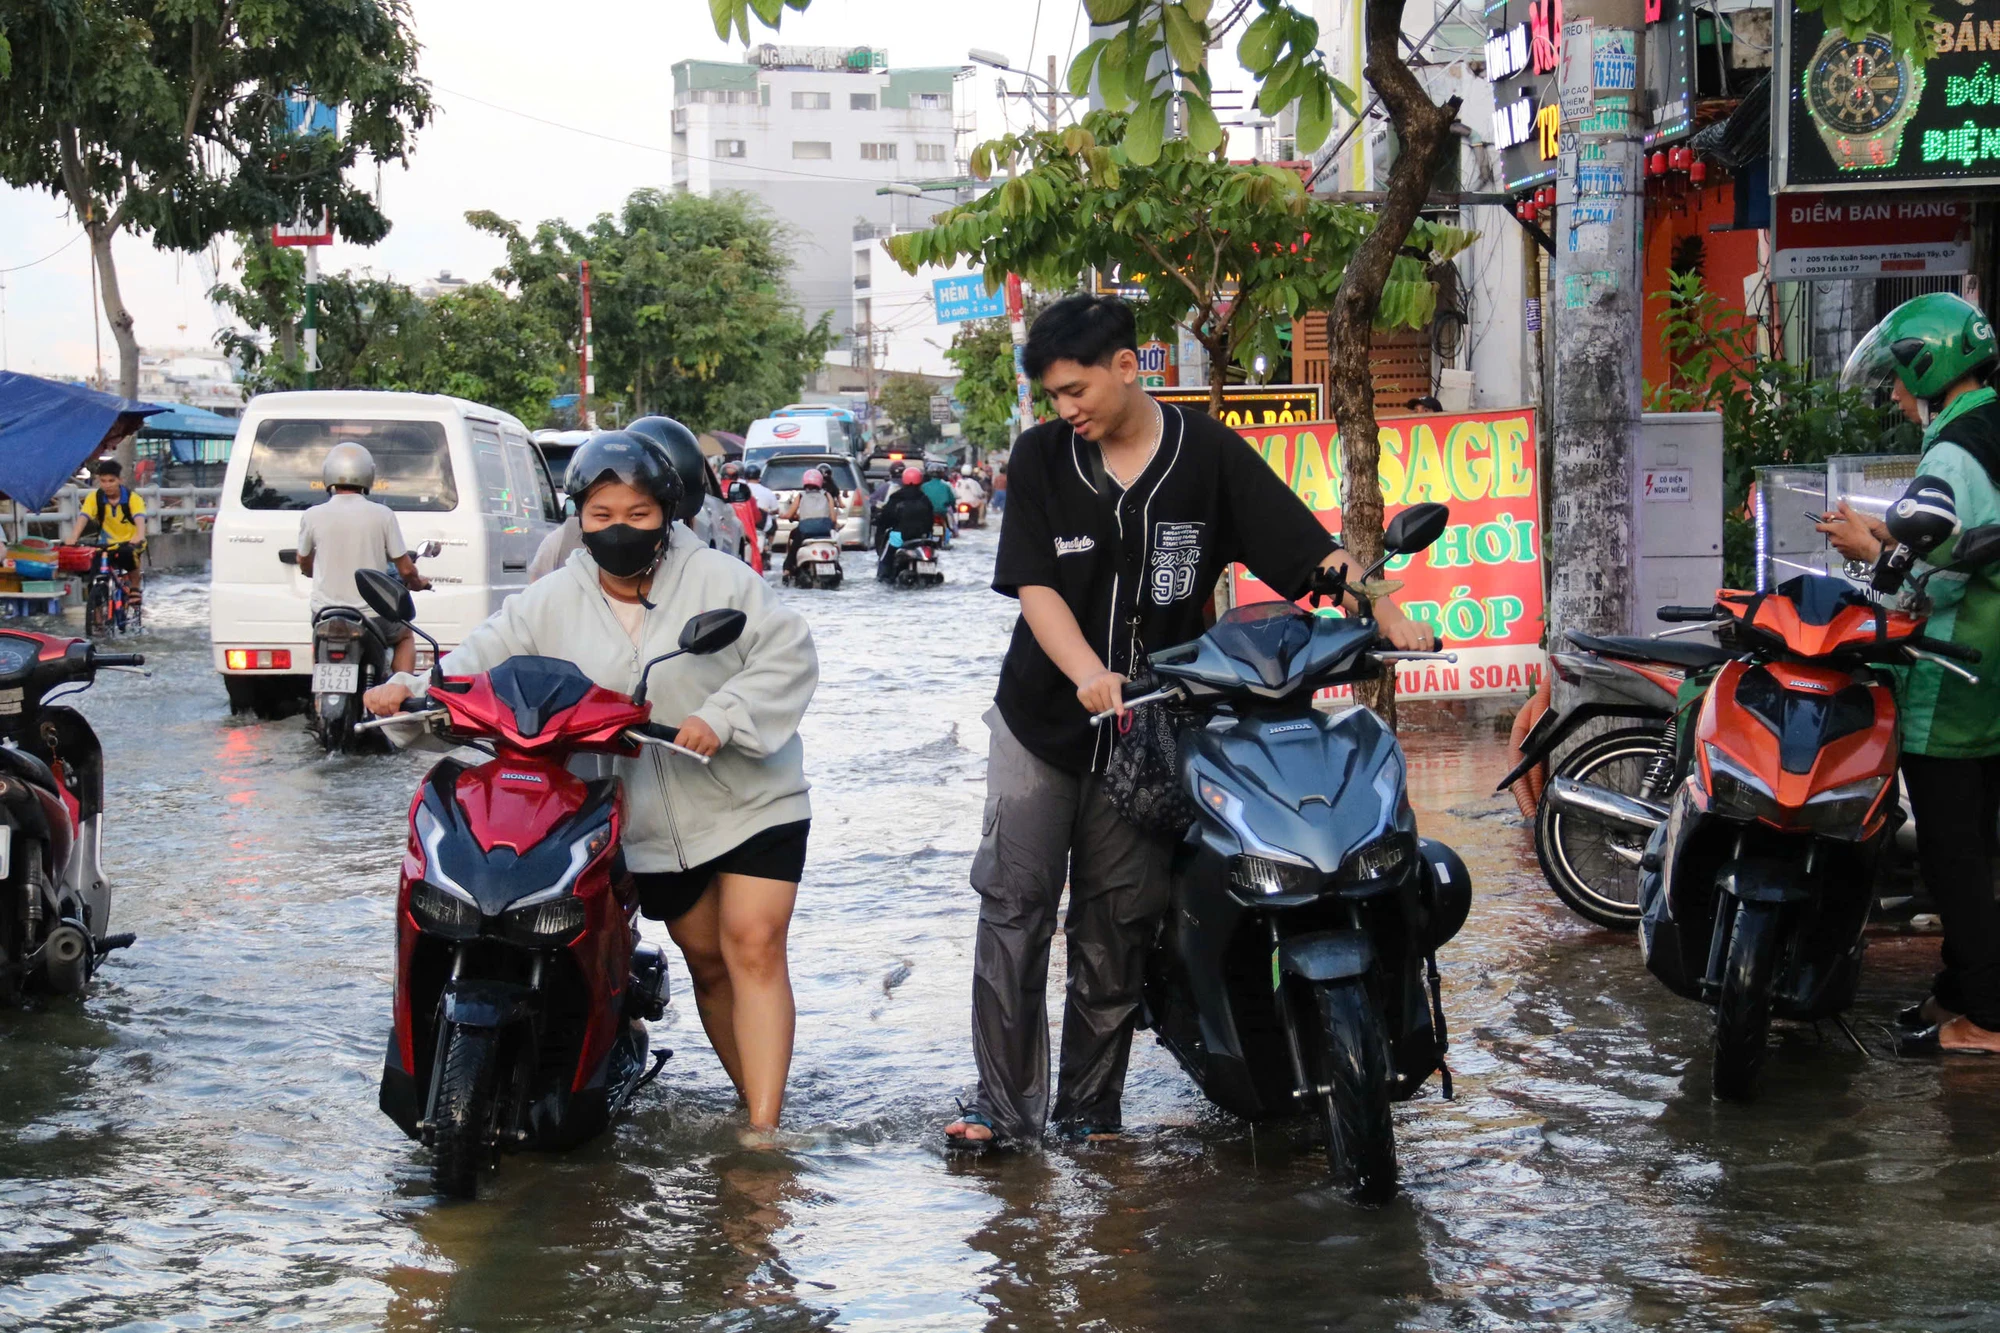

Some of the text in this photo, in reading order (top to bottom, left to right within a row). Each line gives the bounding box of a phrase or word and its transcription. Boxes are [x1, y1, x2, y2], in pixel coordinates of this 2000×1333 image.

[848, 50, 887, 67] HOTEL
[1806, 255, 1821, 263] 205
[1805, 264, 1860, 274] 0939 16 16 77
[1138, 344, 1166, 372] HỚT
[1427, 511, 1538, 569] HƠI
[1054, 535, 1095, 558] Kenstyle
[319, 678, 349, 690] 9421
[1269, 723, 1312, 735] HONDA
[500, 773, 543, 783] HONDA
